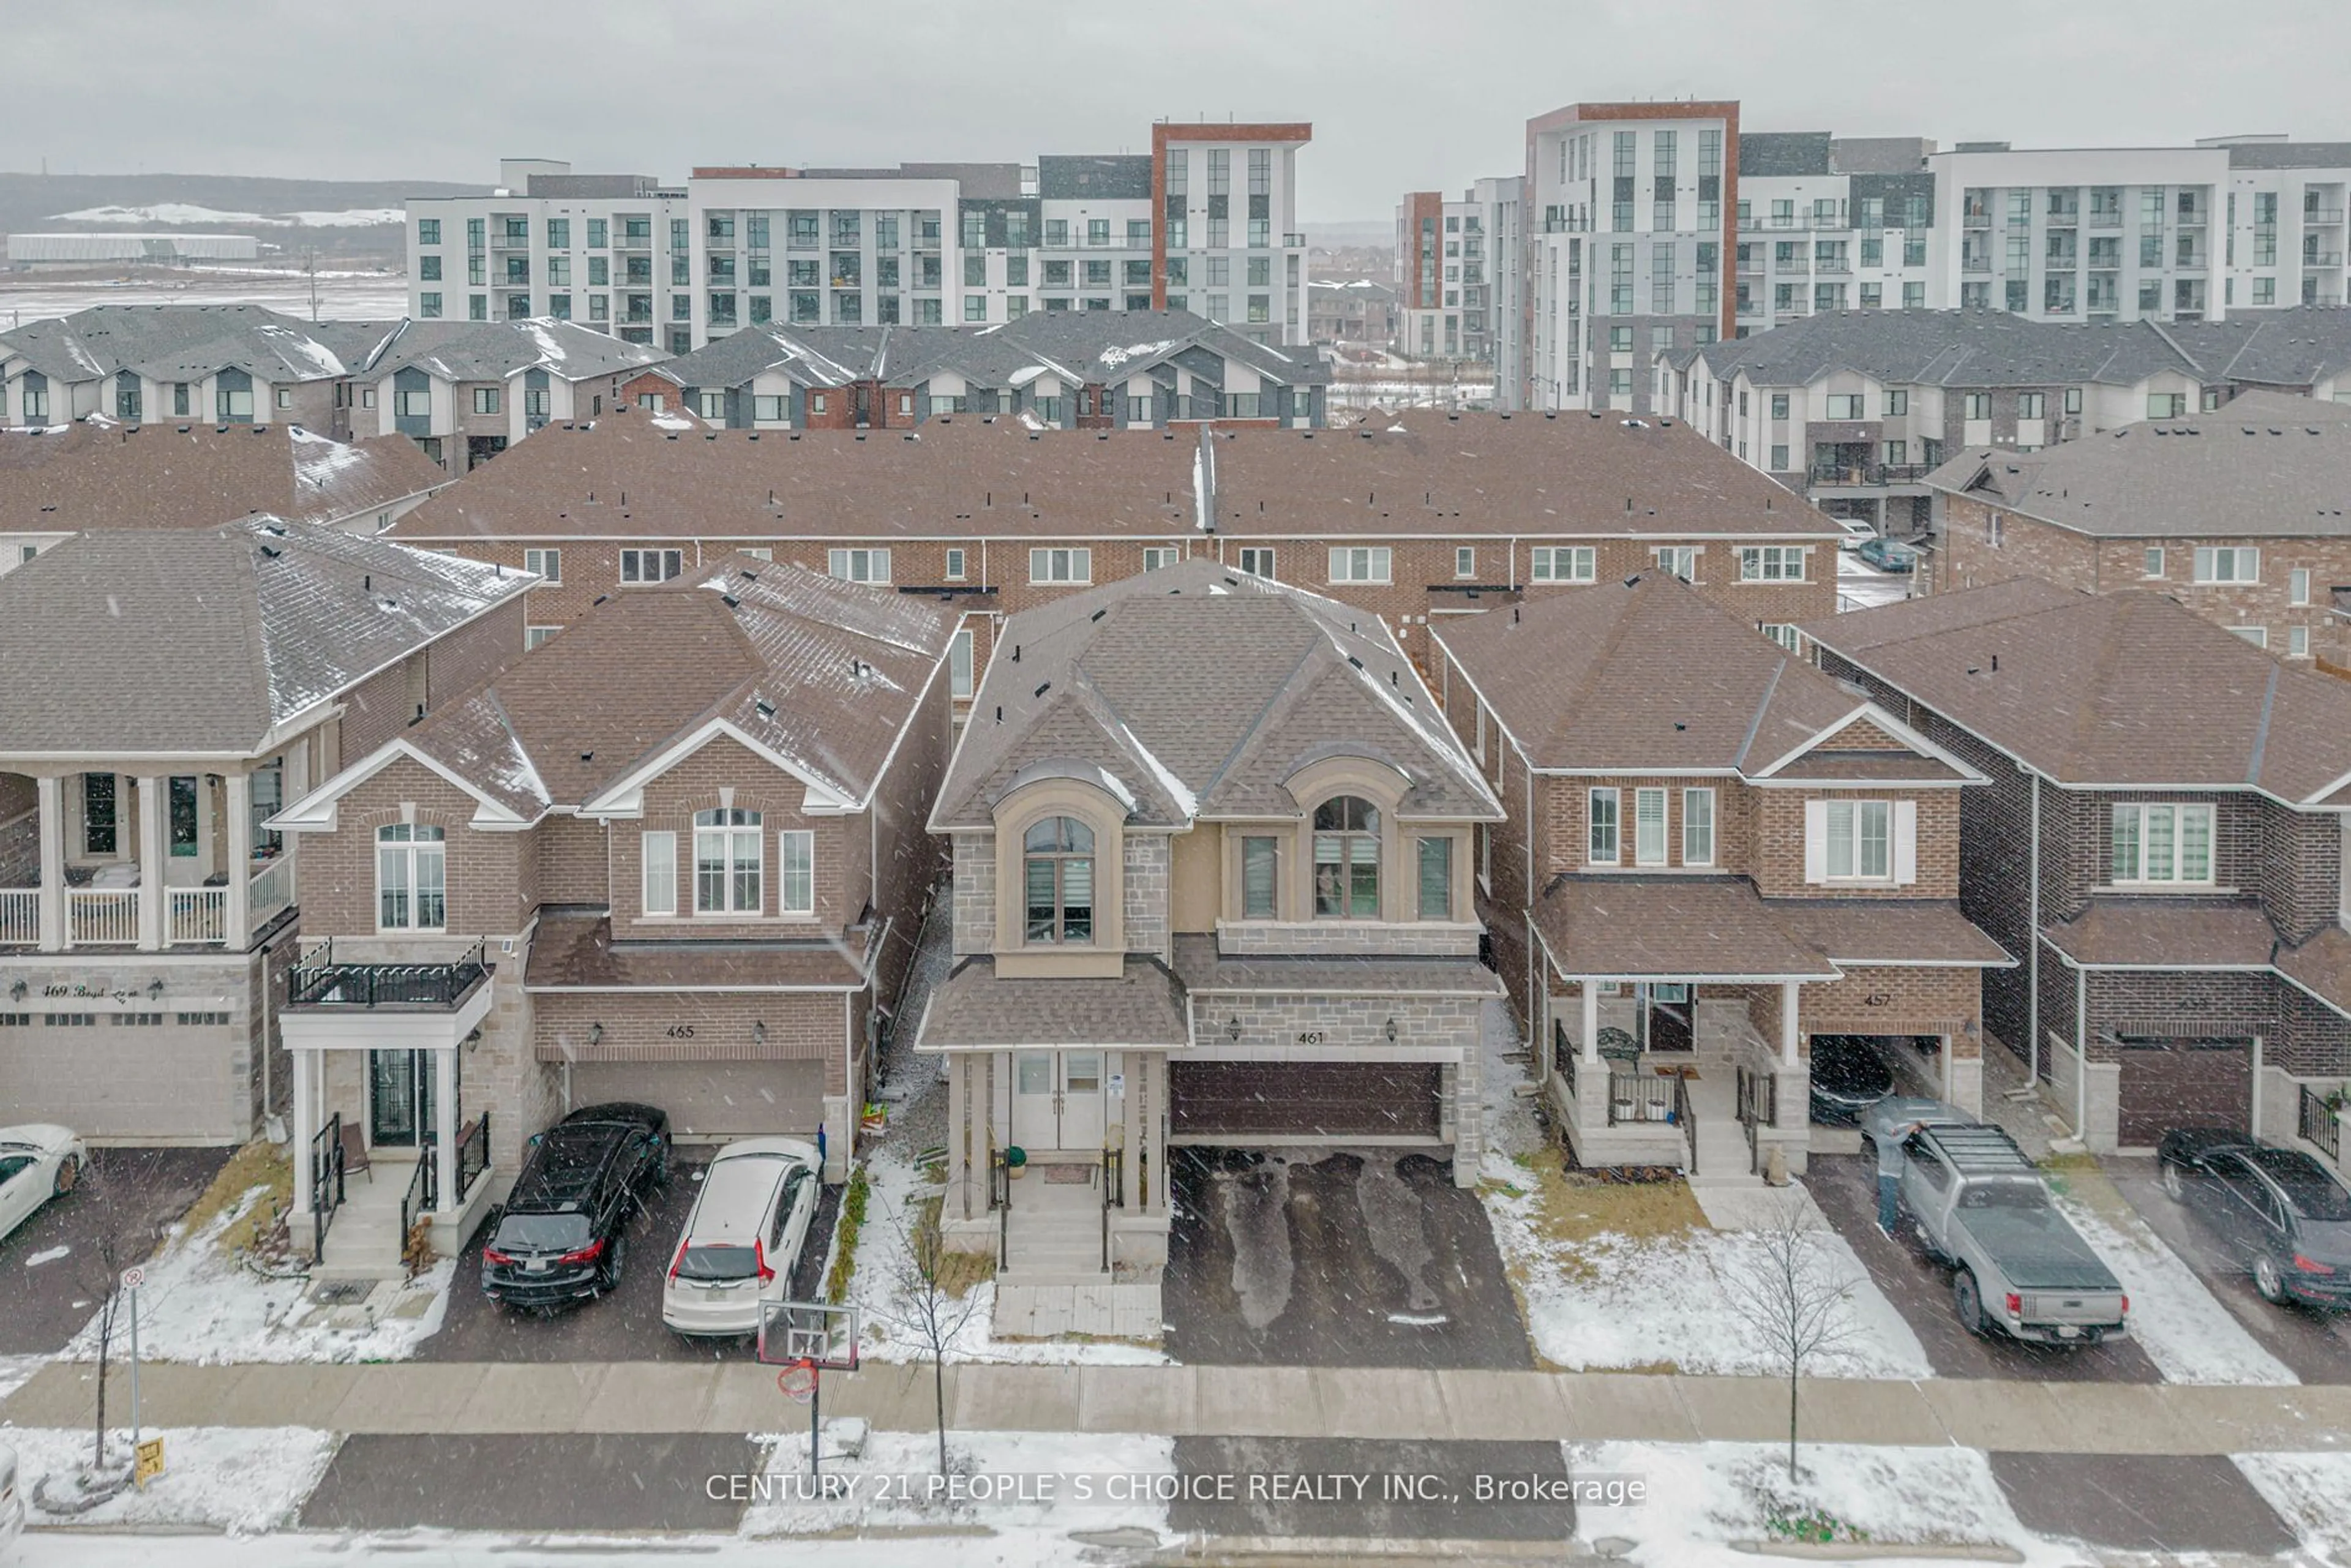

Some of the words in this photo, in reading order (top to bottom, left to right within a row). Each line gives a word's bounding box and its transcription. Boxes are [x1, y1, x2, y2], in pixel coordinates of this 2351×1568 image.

[43, 985, 68, 997] 469
[1864, 993, 1890, 1007] 457
[667, 1026, 694, 1038] 465
[1299, 1032, 1322, 1045] 461
